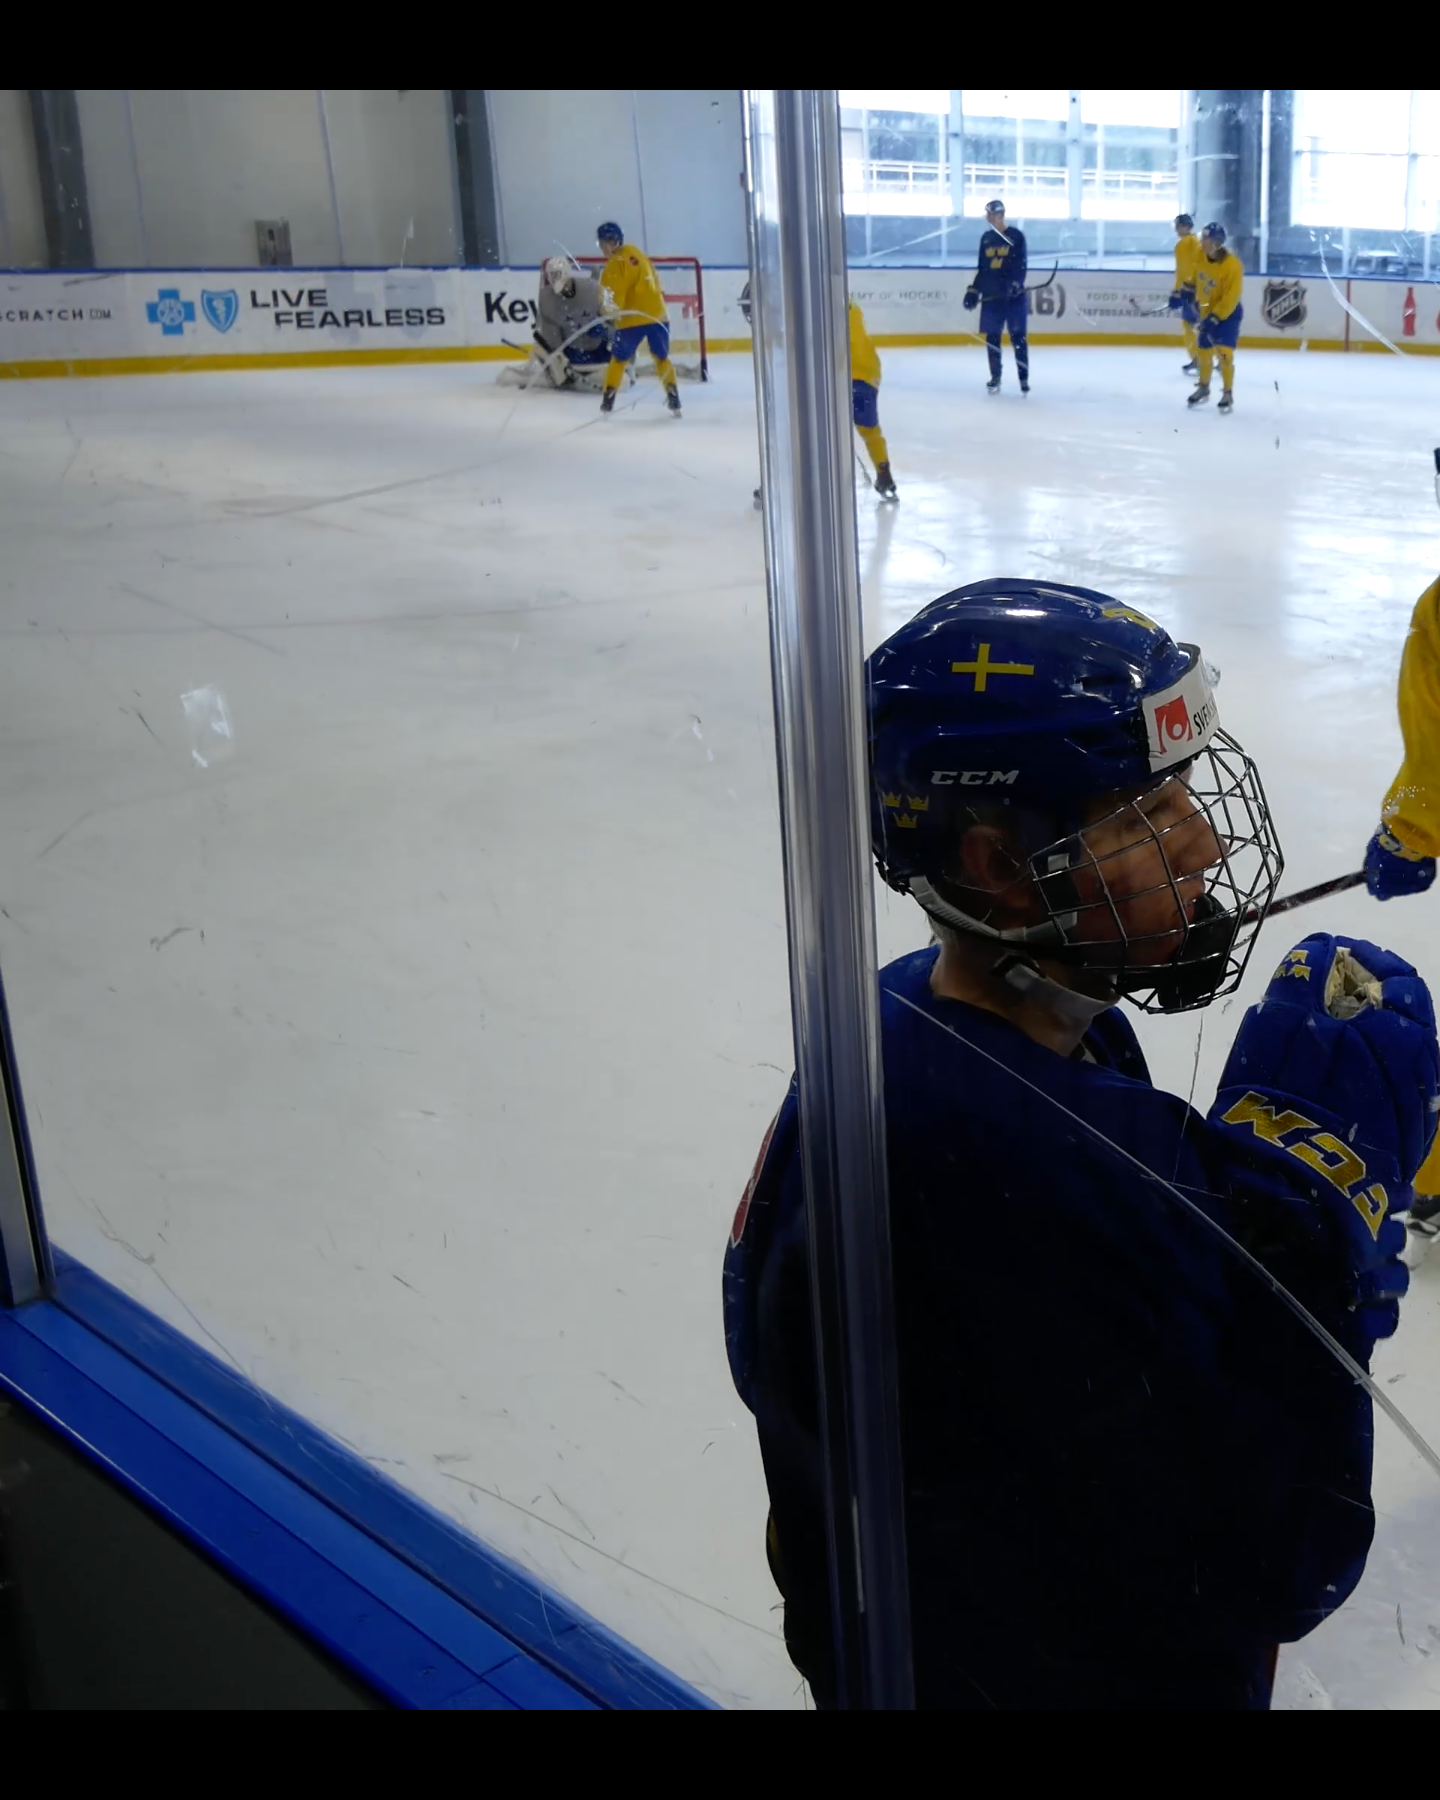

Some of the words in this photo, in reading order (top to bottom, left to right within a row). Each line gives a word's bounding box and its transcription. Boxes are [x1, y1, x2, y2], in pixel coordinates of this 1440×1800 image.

[250, 289, 328, 308] LIVE
[0, 309, 84, 322] CRATCH
[274, 307, 446, 328] FEARLESS
[931, 770, 1019, 785] CCM
[1221, 1090, 1388, 1241] CCM
